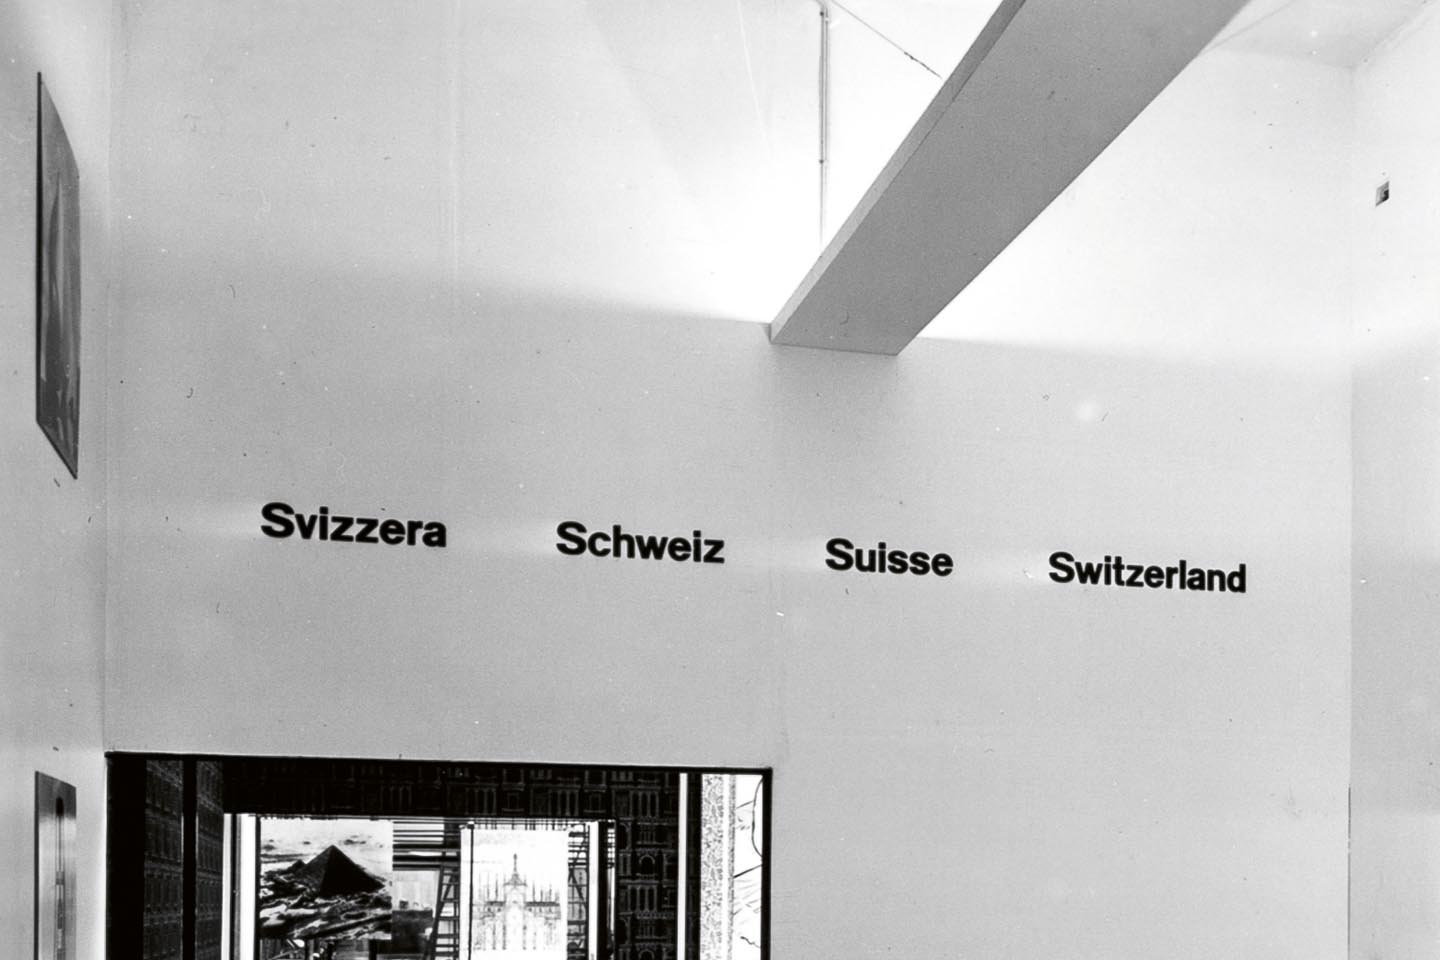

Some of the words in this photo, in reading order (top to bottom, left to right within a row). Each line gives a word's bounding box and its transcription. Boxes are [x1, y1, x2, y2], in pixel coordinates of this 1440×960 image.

[261, 502, 446, 547] Svizzera
[557, 522, 724, 563] Schweiz
[826, 538, 953, 576] Suisse
[1050, 552, 1246, 593] Switzerland
